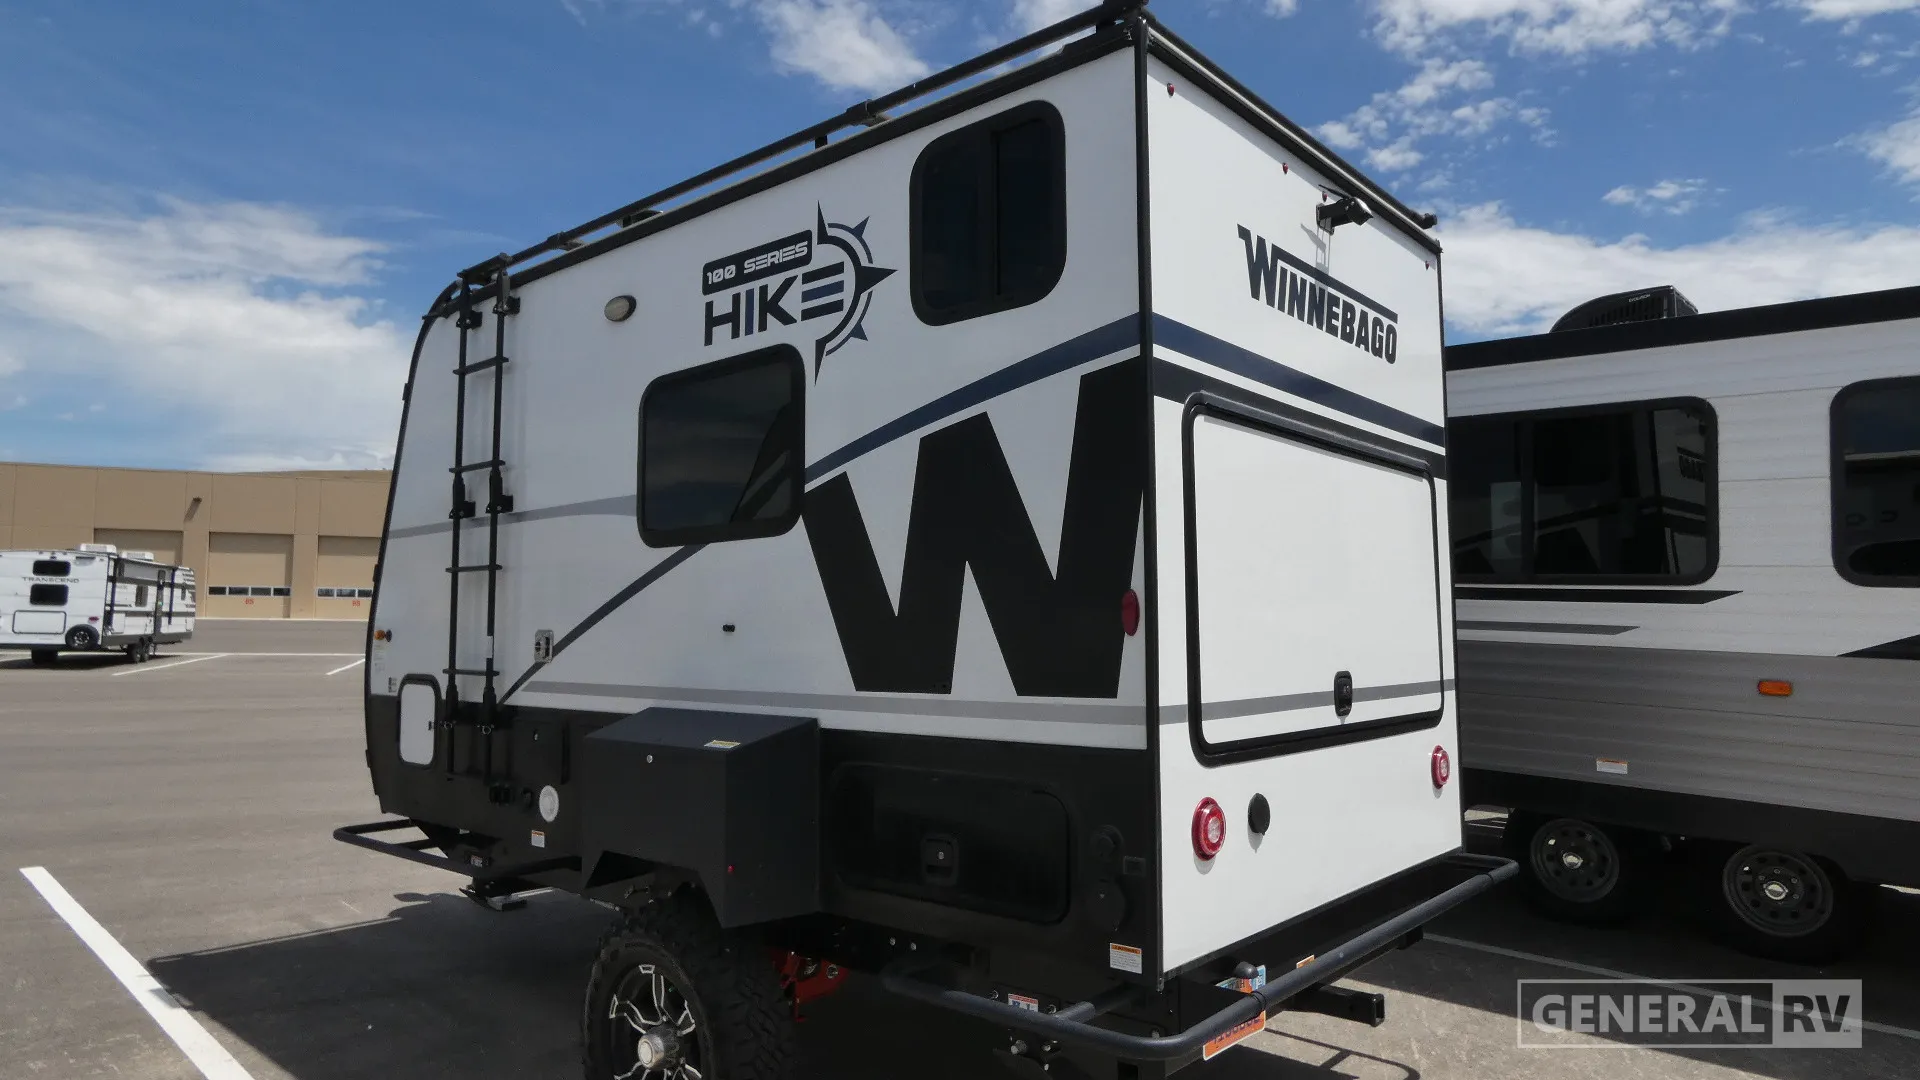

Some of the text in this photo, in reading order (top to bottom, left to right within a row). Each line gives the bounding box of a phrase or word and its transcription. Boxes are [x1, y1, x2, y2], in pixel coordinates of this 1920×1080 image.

[706, 240, 808, 285] 100 SERIES
[1237, 223, 1398, 365] WINNEBAGO
[703, 261, 845, 347] HIKE
[22, 576, 80, 584] TRANSCEND
